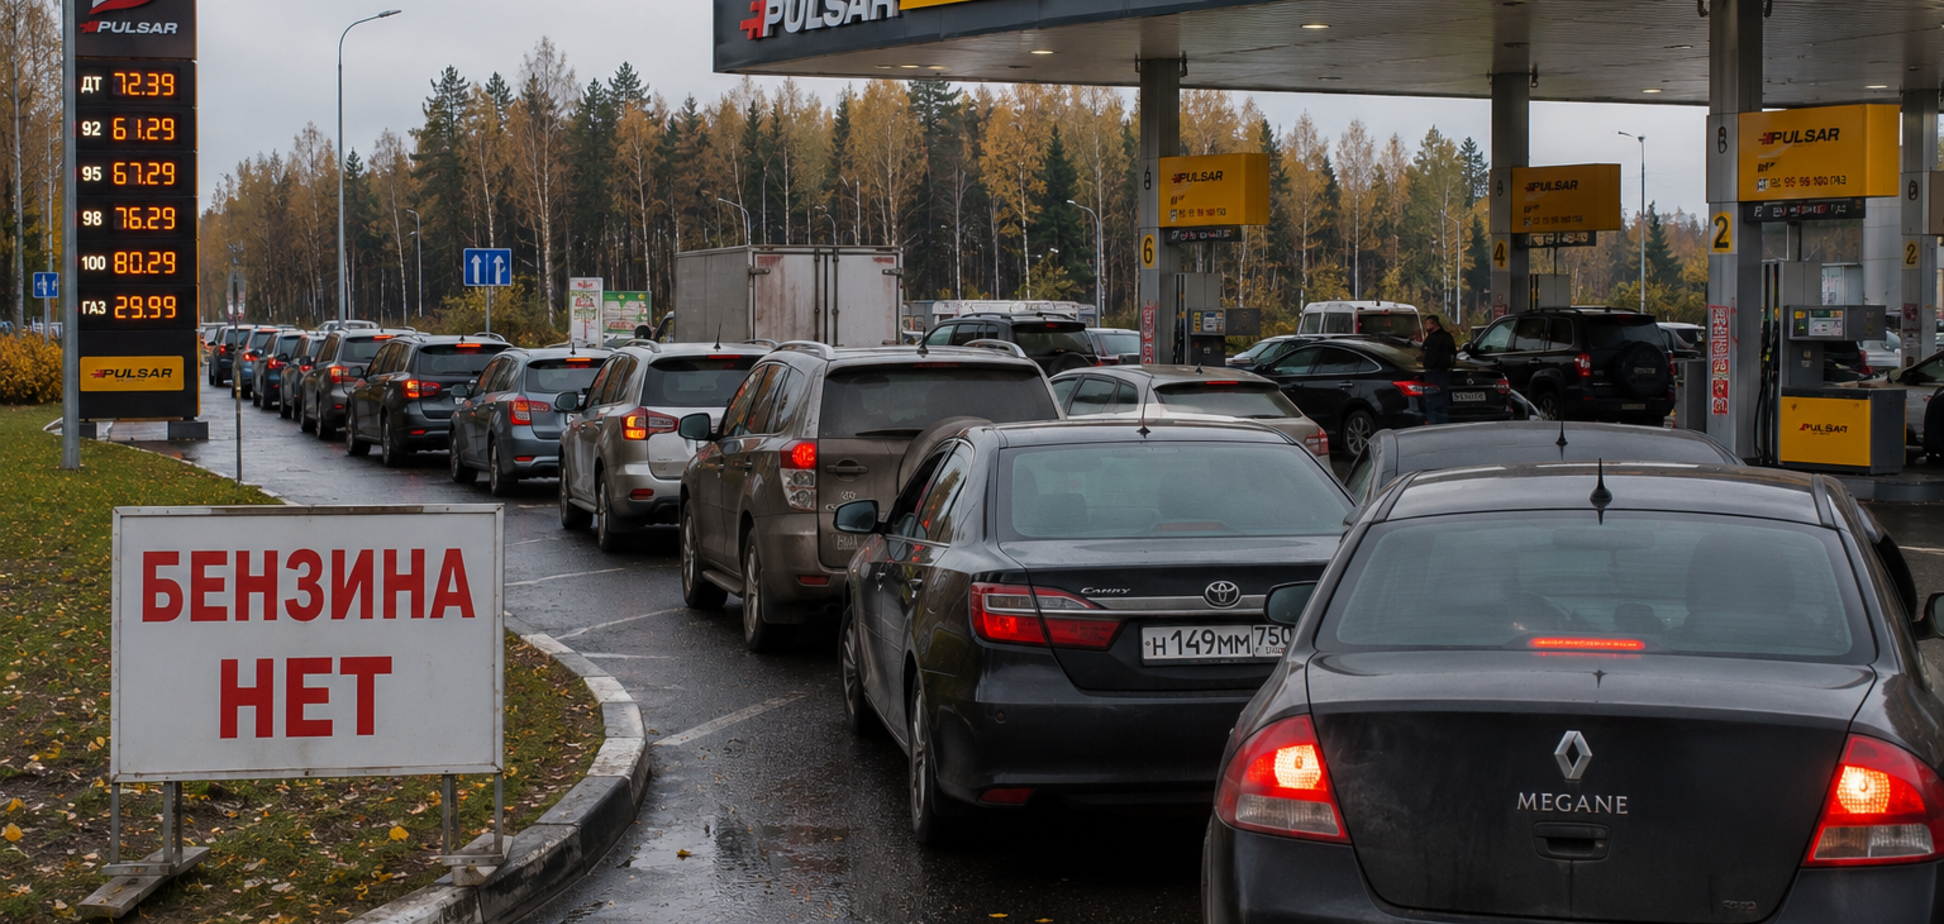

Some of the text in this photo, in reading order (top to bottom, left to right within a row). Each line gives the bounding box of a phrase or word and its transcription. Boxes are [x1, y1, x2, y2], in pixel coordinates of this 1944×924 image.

[97, 21, 178, 34] PULSAR
[81, 72, 175, 96] ДТ 72.39
[81, 117, 175, 140] 92 61.29
[1770, 128, 1840, 144] PULSAR
[81, 162, 175, 185] 95 67.29
[1179, 171, 1223, 182] PULSAR
[1532, 180, 1578, 191] PULSAR
[82, 207, 176, 229] 98 76.29
[1714, 215, 1729, 249] 2
[1143, 237, 1153, 264] 6
[1493, 242, 1505, 268] 4
[1906, 243, 1917, 265] 2
[81, 252, 176, 274] 100 80.29
[82, 296, 176, 318] ГАЗ 29.99
[101, 368, 173, 378] PULSAR
[142, 548, 476, 622] БЕНЗИНА
[1255, 625, 1292, 646] 750
[219, 656, 393, 739] НЕТ
[1516, 792, 1629, 815] MEGANE
